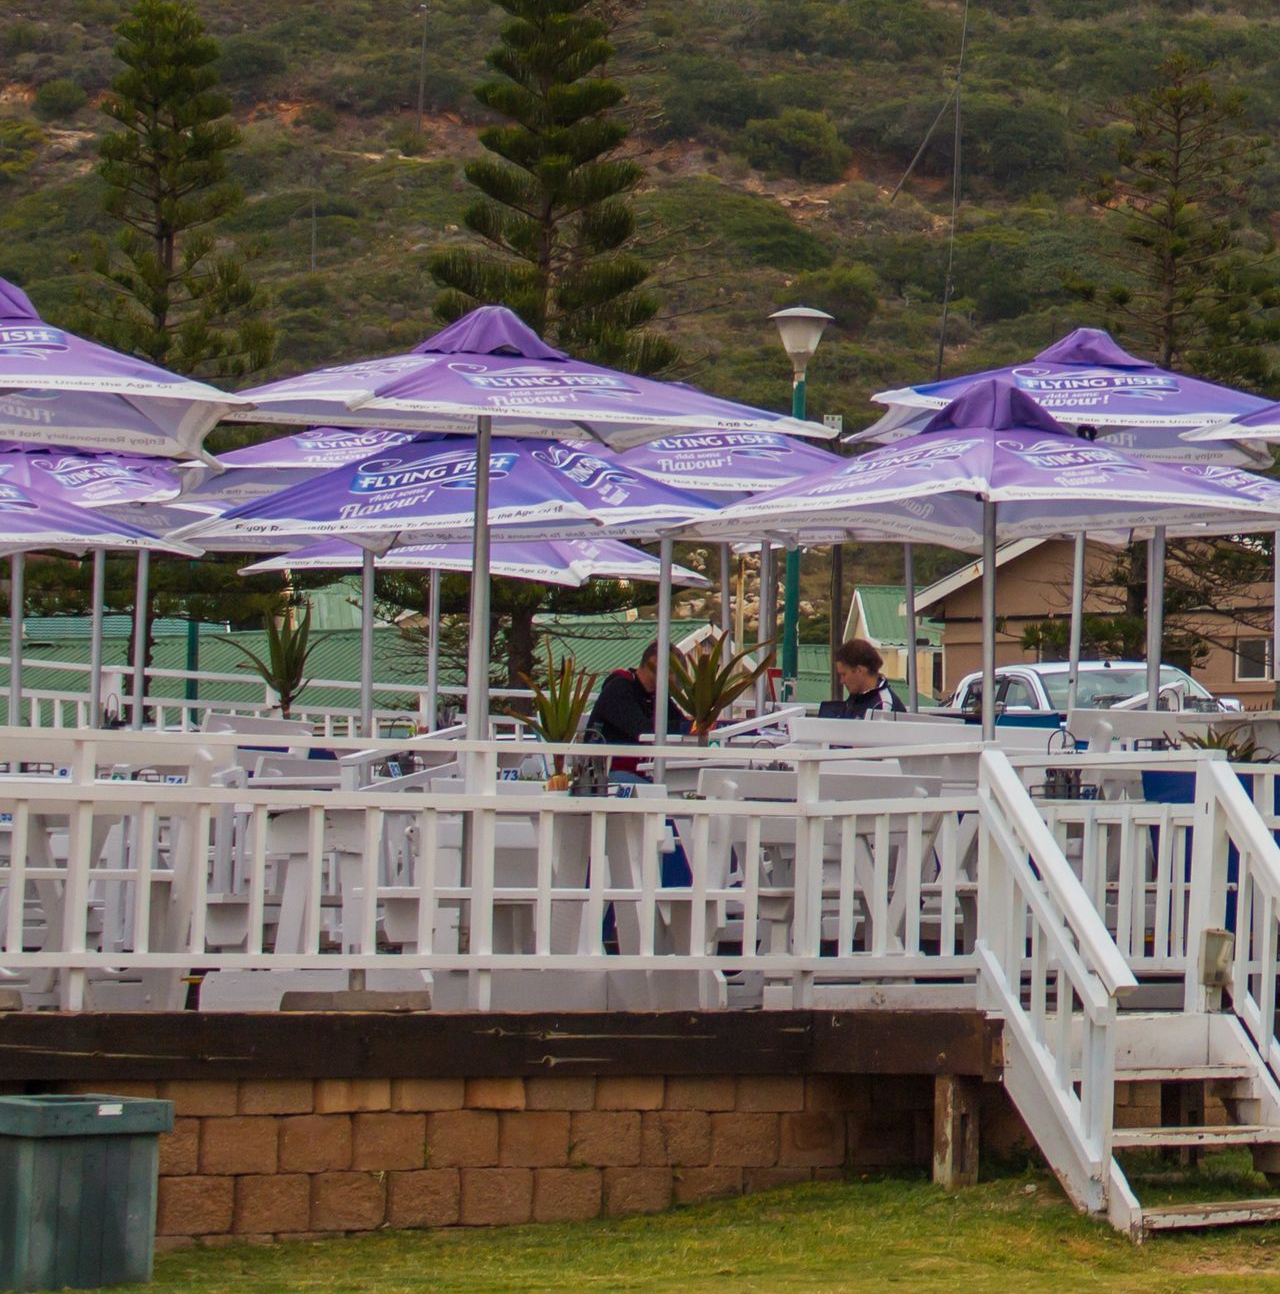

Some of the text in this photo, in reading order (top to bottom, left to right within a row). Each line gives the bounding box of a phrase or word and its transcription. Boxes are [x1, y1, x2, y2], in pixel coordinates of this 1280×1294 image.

[125, 382, 153, 390] Age
[474, 375, 618, 387] FLYING FISH
[1025, 376, 1173, 389] FLYING FISH
[487, 392, 578, 406] Flavour!
[1037, 394, 1111, 407] lavour!
[303, 436, 377, 451] FLYING
[652, 434, 779, 449] FLYING FISH
[657, 454, 733, 473] Flavour!
[1028, 450, 1085, 467] FLYING
[360, 465, 447, 489] FLYING
[369, 487, 428, 504] Add some
[339, 489, 436, 521] Flavour!
[497, 504, 564, 520] the Age 18
[420, 519, 464, 528] Persons
[503, 769, 519, 781] 73
